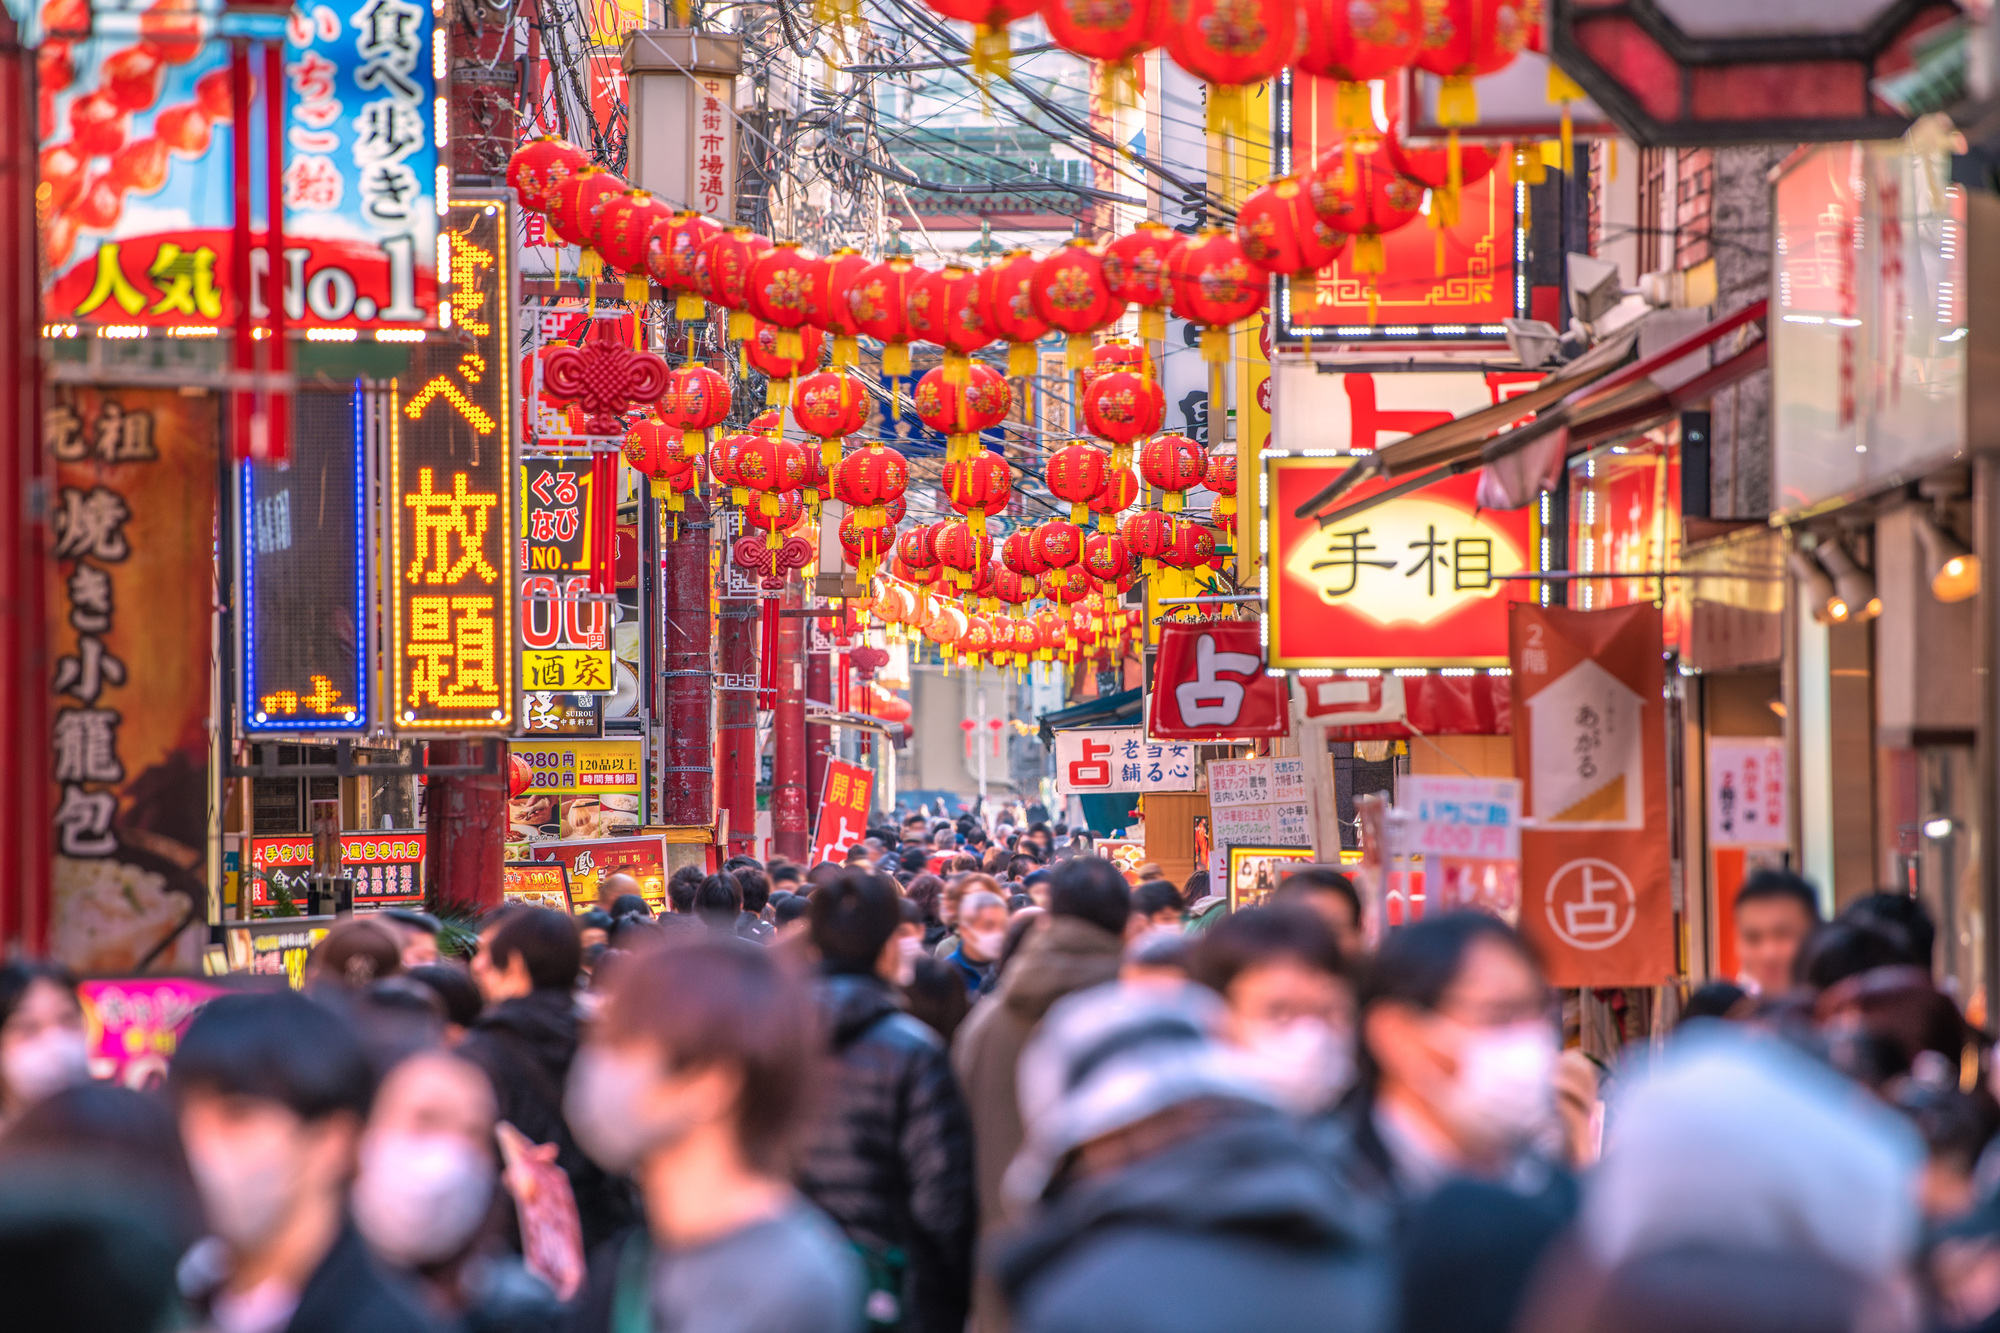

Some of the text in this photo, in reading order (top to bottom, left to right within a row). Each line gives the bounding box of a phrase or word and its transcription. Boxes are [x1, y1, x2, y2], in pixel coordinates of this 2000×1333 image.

[286, 5, 342, 208] いちご飴
[357, 0, 424, 221] 食べ歩き
[700, 79, 724, 213] 中華街市場通り
[75, 236, 426, 321] 人気 No.1
[44, 404, 158, 462] 元祖
[531, 470, 578, 505] ぐる
[531, 508, 579, 542] なび
[1311, 524, 1492, 597] 手相
[53, 487, 129, 857] 焼き小籠包
[531, 654, 606, 686] 酒家
[1521, 623, 1548, 674] 2階
[1175, 632, 1260, 728] 占
[560, 718, 594, 726] 中華料理
[566, 710, 594, 718] SUIROU
[579, 758, 637, 771] 120品以上
[1069, 738, 1111, 786] 占
[1121, 739, 1141, 782] 老舗
[1574, 704, 1602, 779] あがる
[583, 773, 636, 784] 時間無制限
[1212, 763, 1266, 778] 開運ストア
[357, 865, 413, 881] 小皿料理
[1564, 865, 1619, 937] 占
